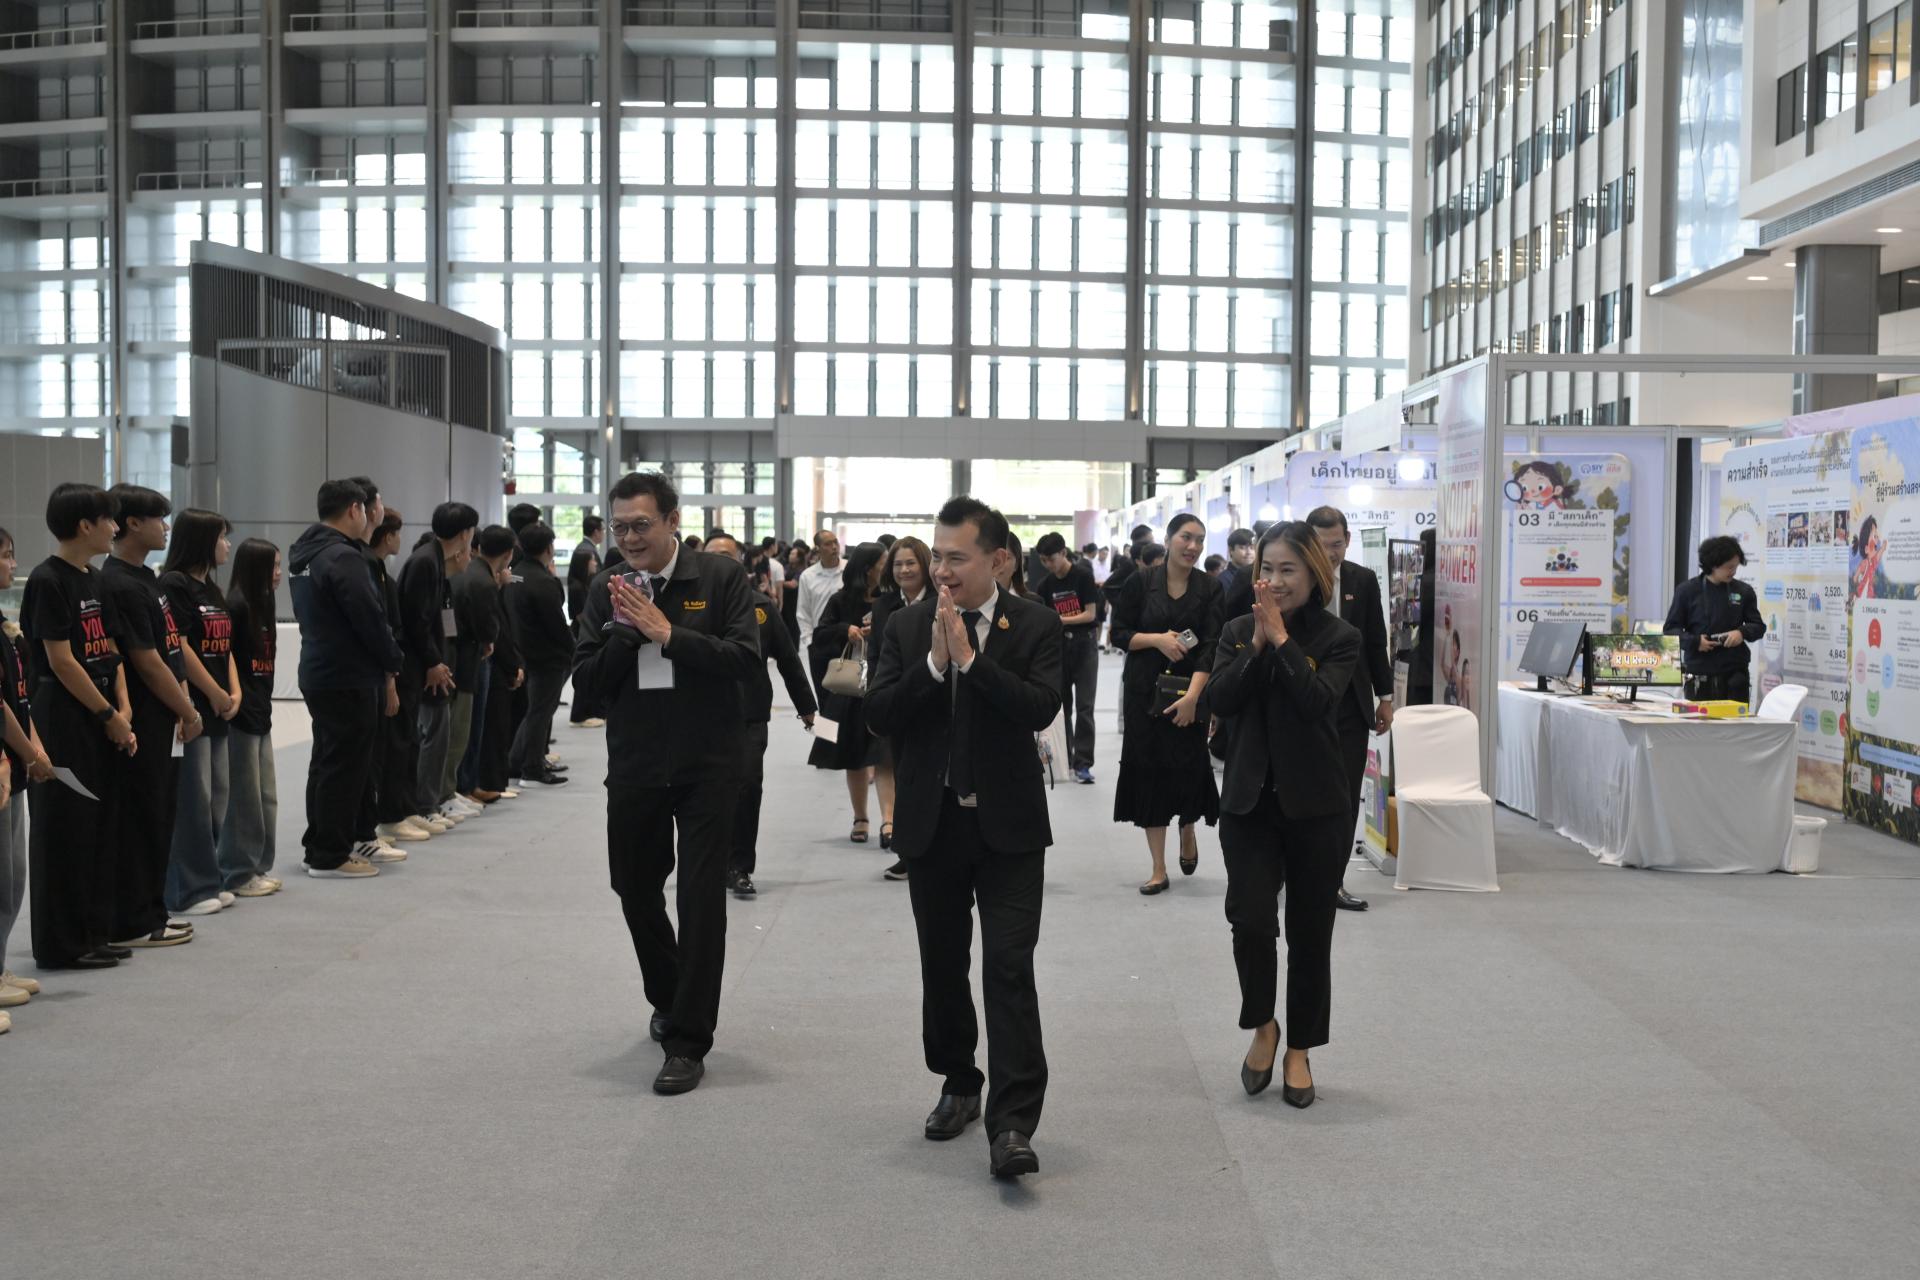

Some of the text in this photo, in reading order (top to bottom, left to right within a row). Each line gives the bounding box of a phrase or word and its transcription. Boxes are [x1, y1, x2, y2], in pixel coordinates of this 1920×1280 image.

[1443, 480, 1479, 539] YOUTH
[1415, 512, 1436, 525] 02
[1519, 513, 1540, 526] 03
[1440, 544, 1477, 584] POWER
[1517, 609, 1539, 622] 06
